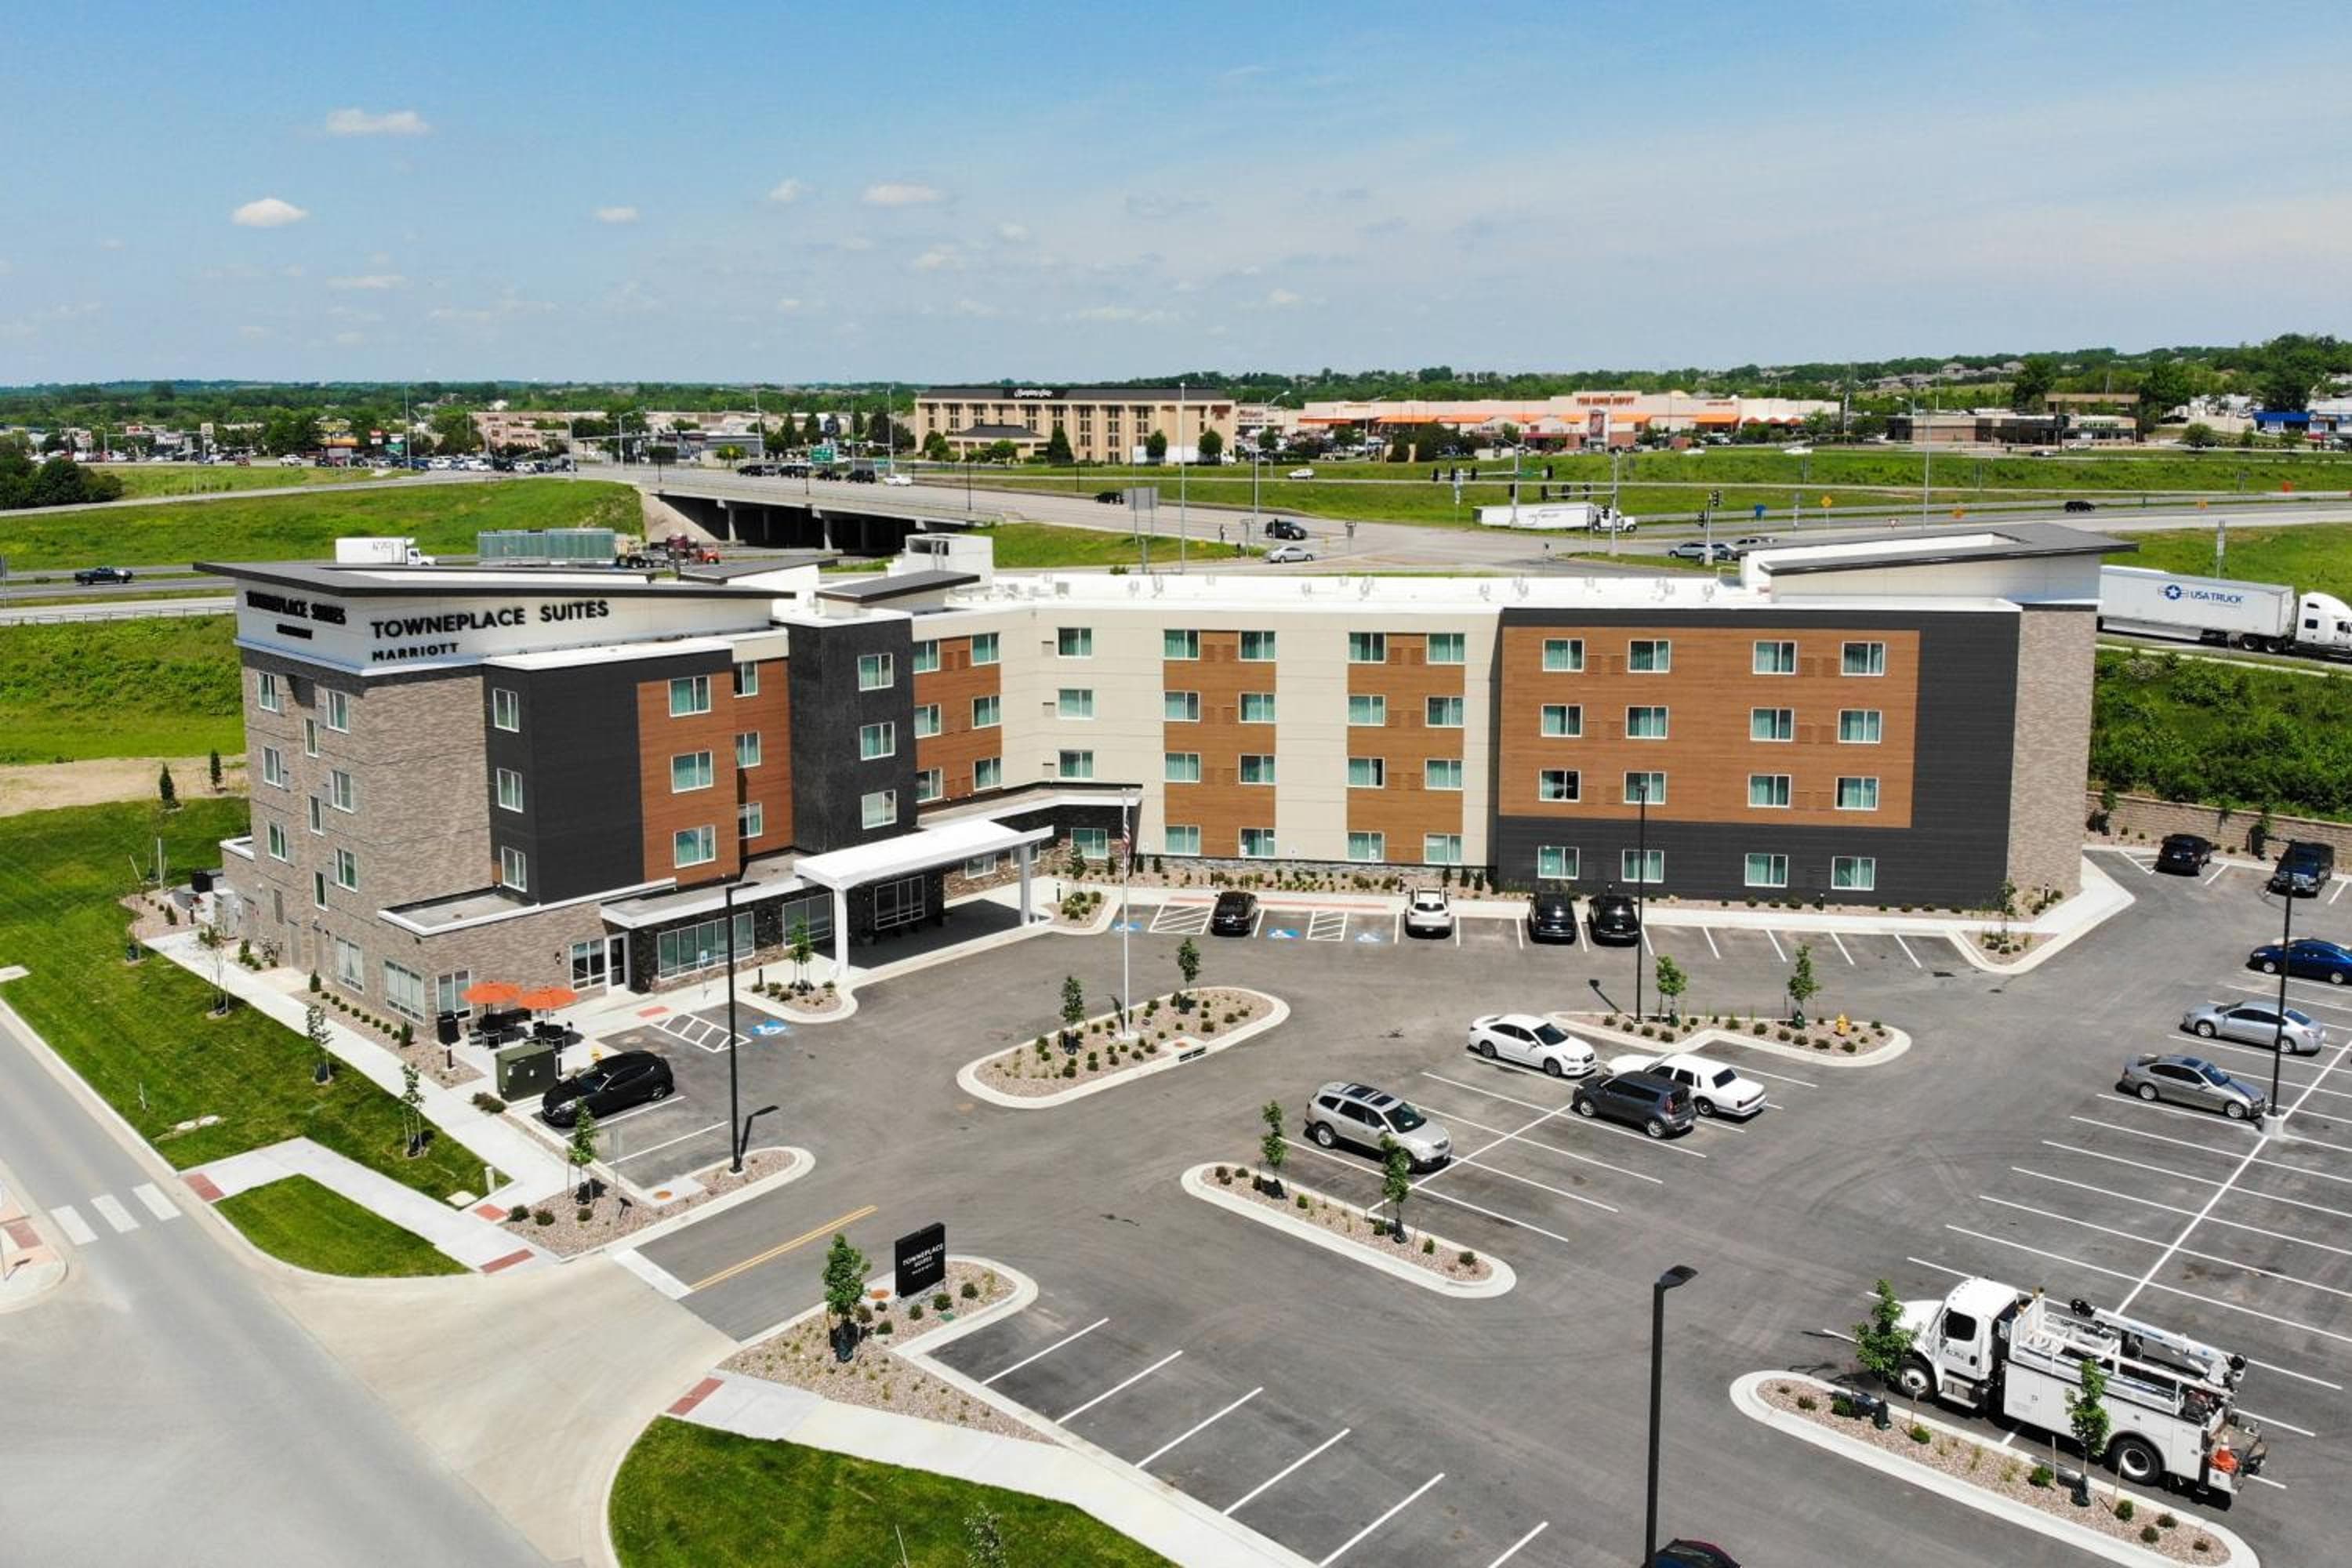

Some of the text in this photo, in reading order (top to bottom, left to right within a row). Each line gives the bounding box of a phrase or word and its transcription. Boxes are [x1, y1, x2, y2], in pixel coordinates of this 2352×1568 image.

[2190, 590, 2244, 604] USA TRUCK
[370, 600, 609, 639] TOWNEPLACE SUITES
[372, 642, 459, 662] MARRIOTT
